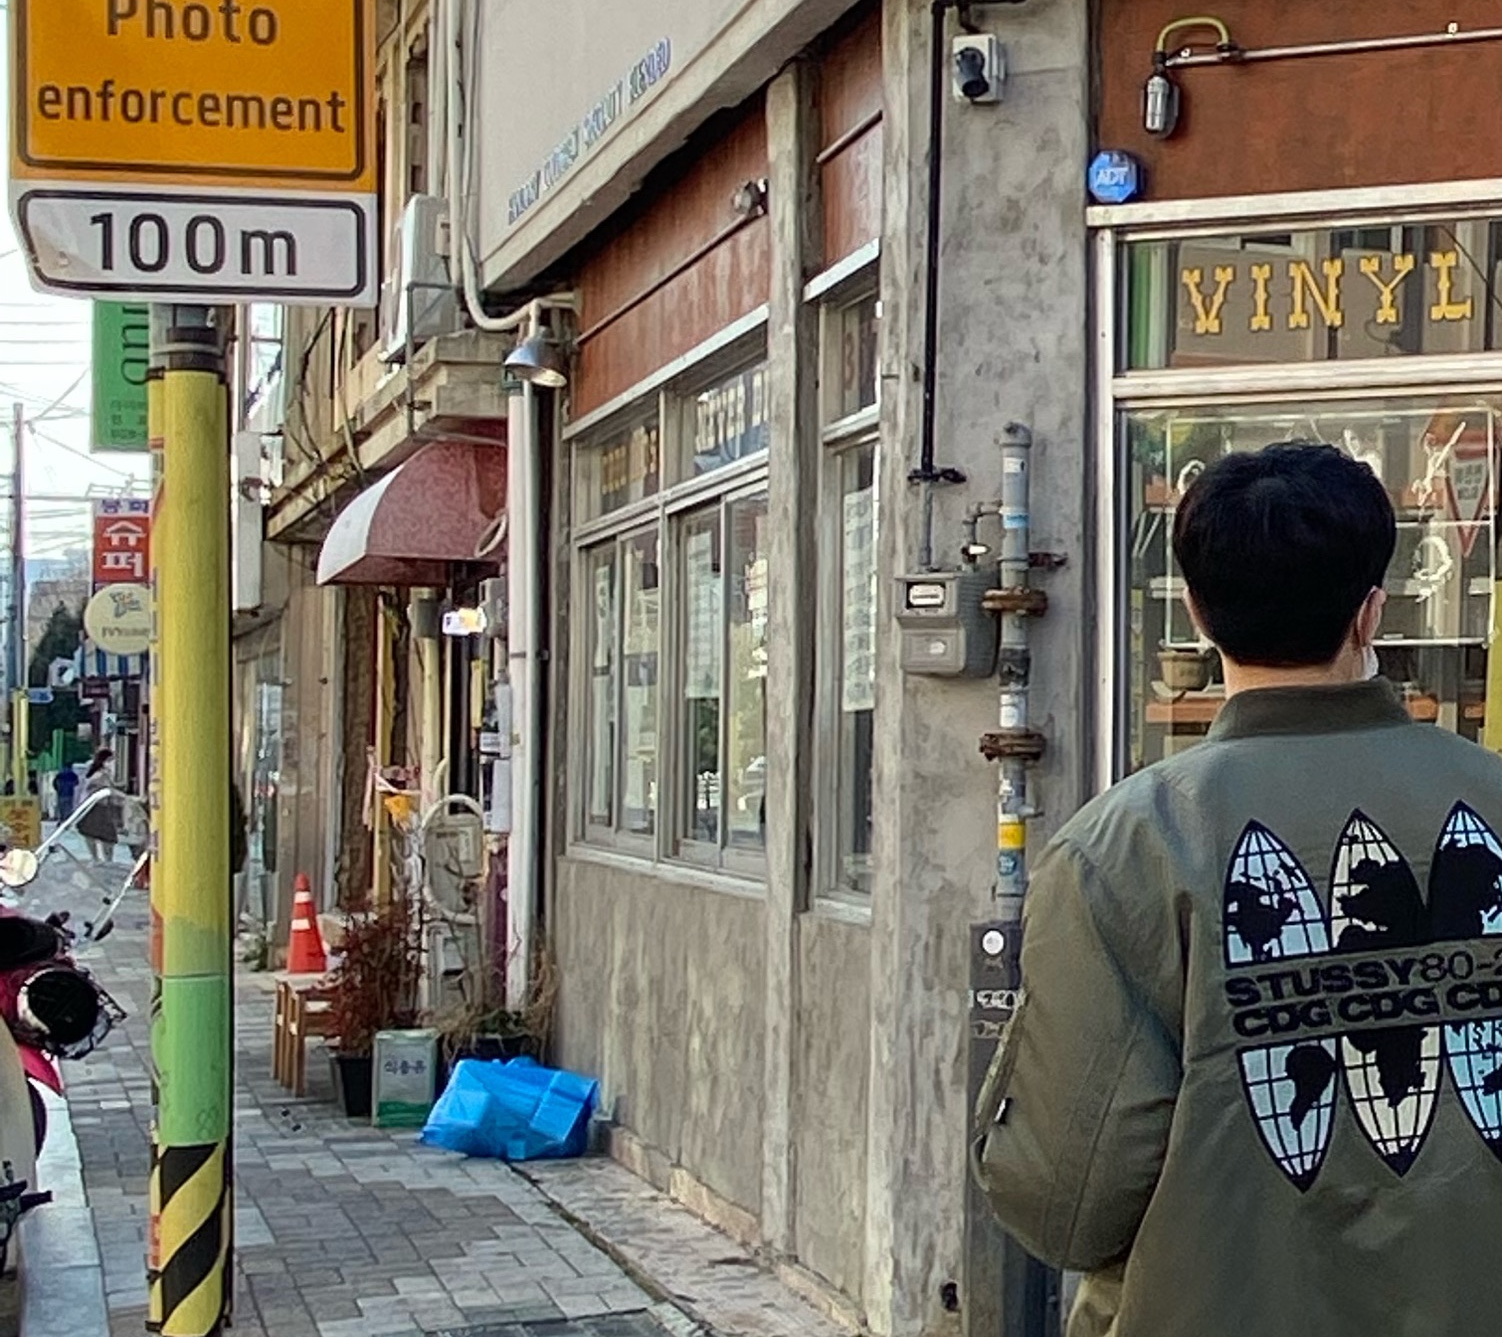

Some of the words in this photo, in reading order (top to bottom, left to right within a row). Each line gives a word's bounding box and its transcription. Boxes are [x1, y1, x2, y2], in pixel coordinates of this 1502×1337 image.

[37, 76, 347, 136] enforcement
[1096, 166, 1129, 186] ADT
[89, 210, 300, 278] 100m
[1181, 249, 1475, 336] VINYL
[102, 520, 147, 578] 슈퍼
[1233, 1001, 1332, 1037] CDG
[1338, 989, 1440, 1023] CDG
